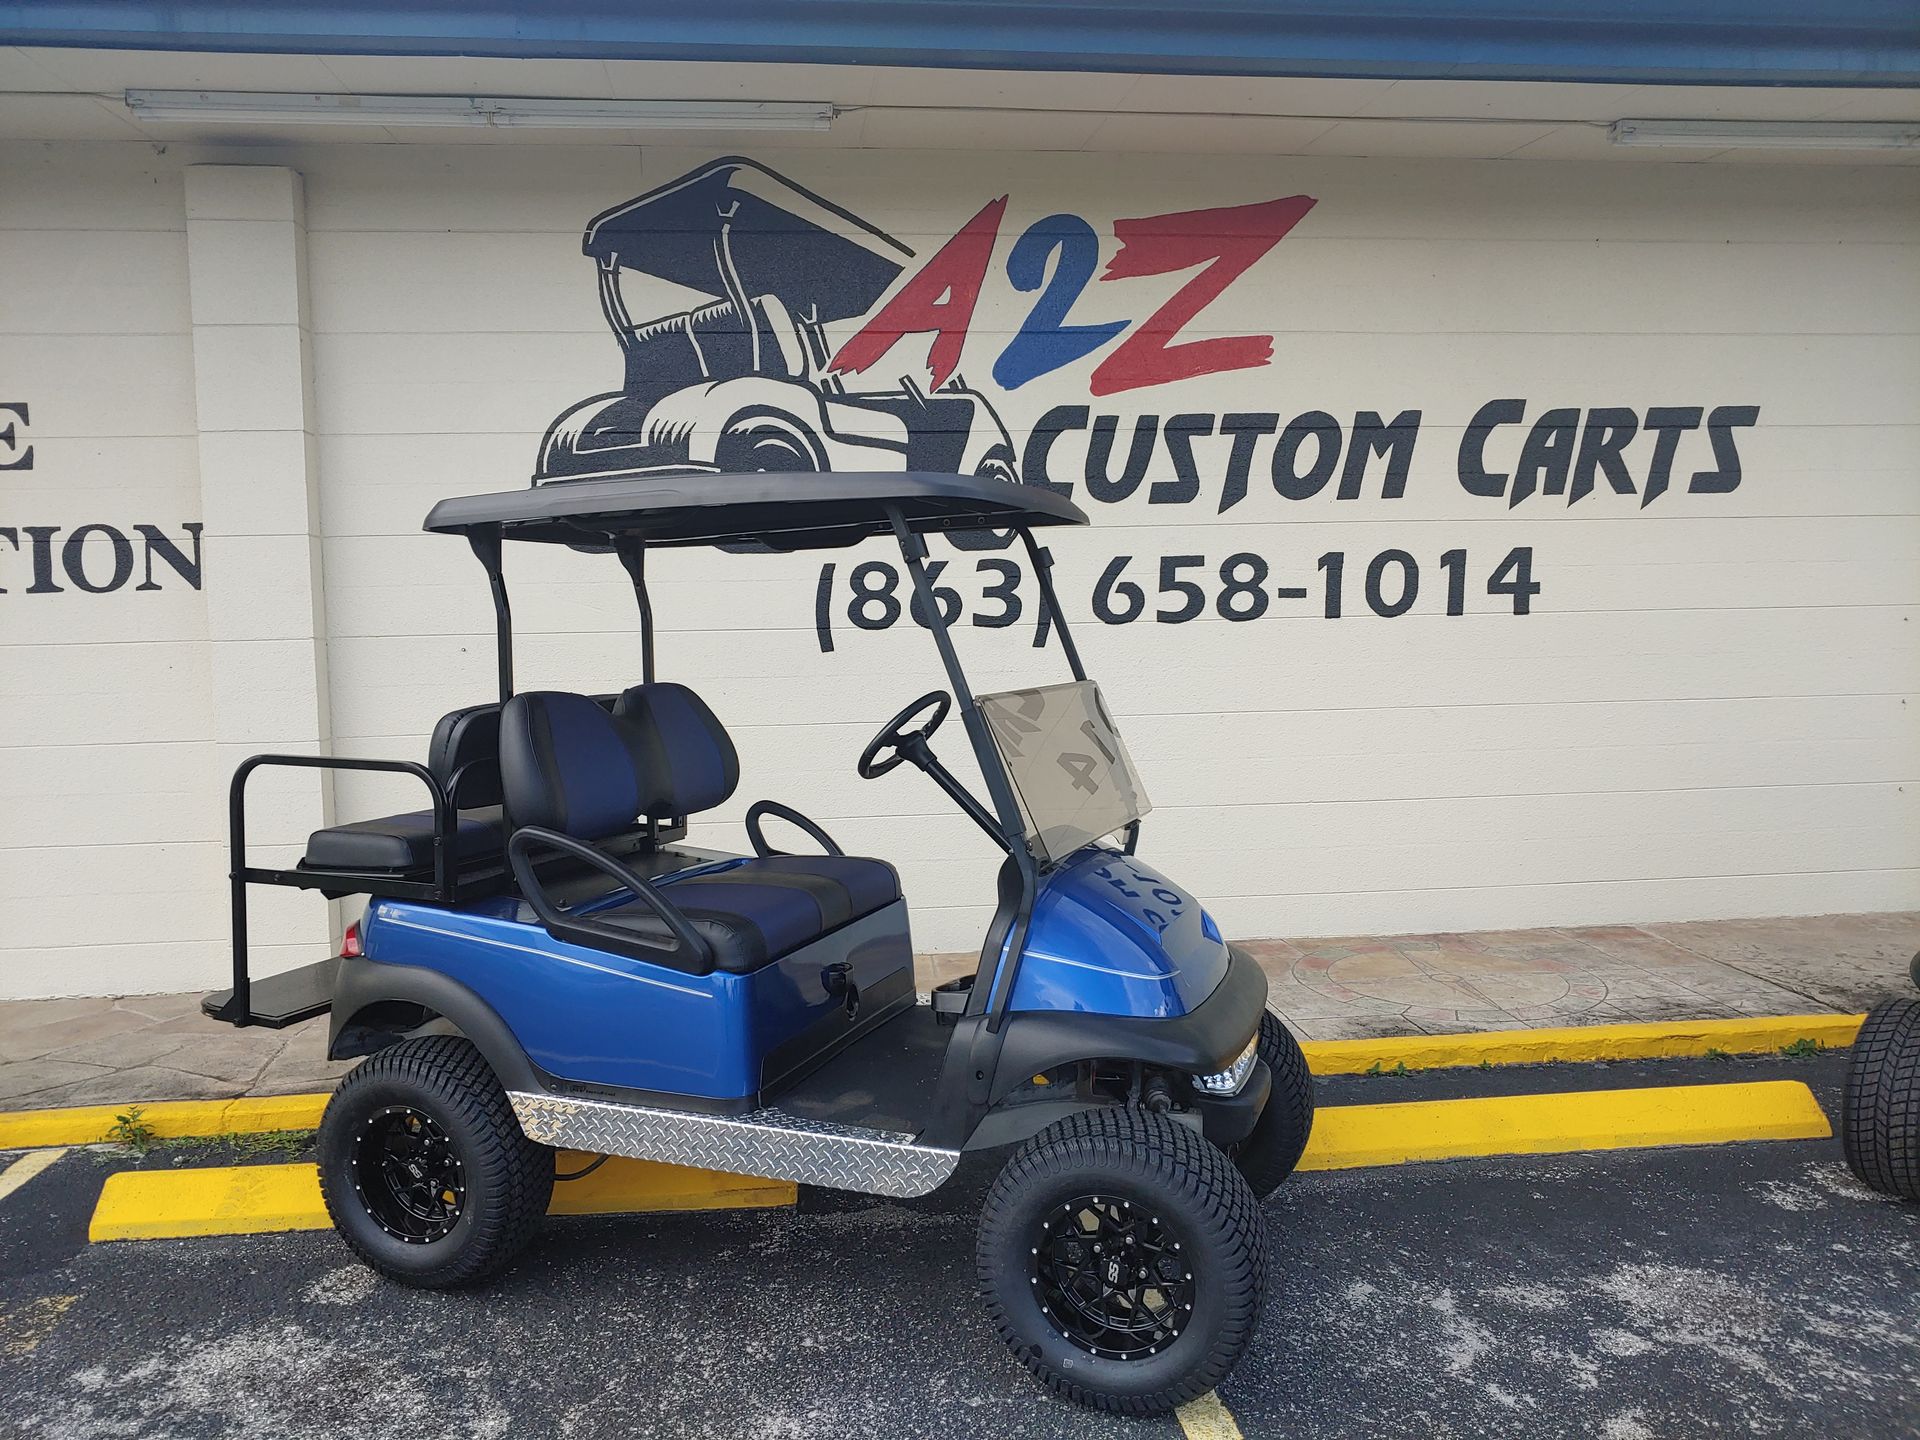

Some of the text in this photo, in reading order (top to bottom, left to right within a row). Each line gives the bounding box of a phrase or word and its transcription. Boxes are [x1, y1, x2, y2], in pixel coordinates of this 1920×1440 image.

[827, 194, 1319, 397] A2Z
[1022, 398, 1761, 515] CUSTOM CARTS
[815, 546, 1541, 653] (863) 658-1014
